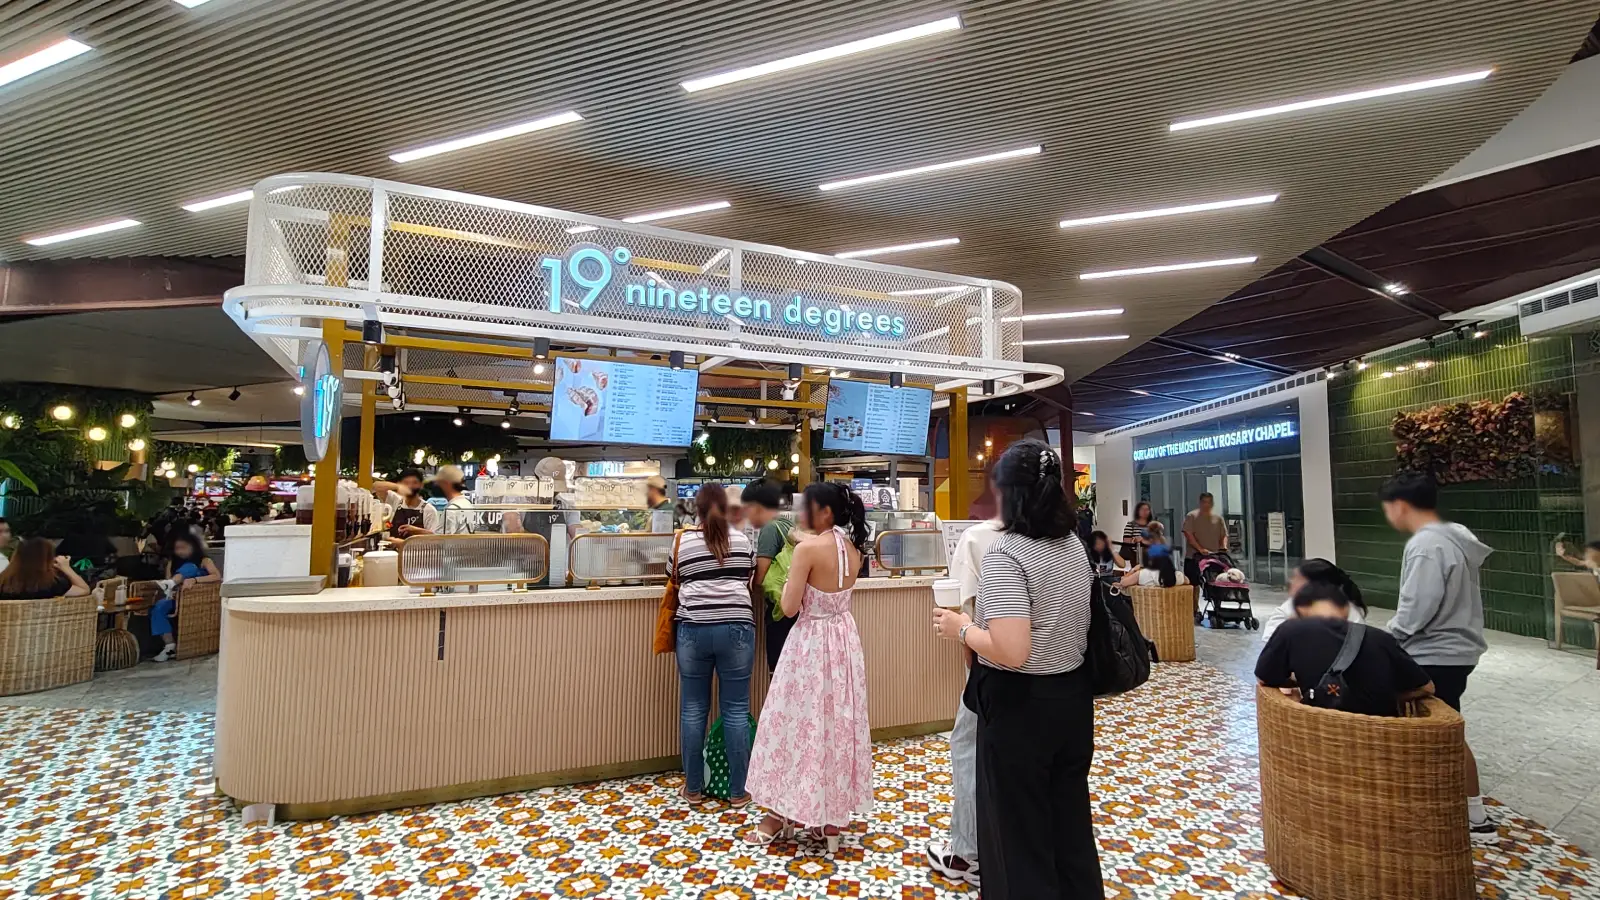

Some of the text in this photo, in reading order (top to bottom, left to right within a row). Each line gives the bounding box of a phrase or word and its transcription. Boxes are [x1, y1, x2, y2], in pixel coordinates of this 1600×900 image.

[626, 279, 771, 321] nineteen
[784, 295, 905, 337] degrees
[1134, 421, 1294, 461] OUR LADY OF THE MOST HOLY ROSARY CHAPEL
[488, 511, 503, 525] UP
